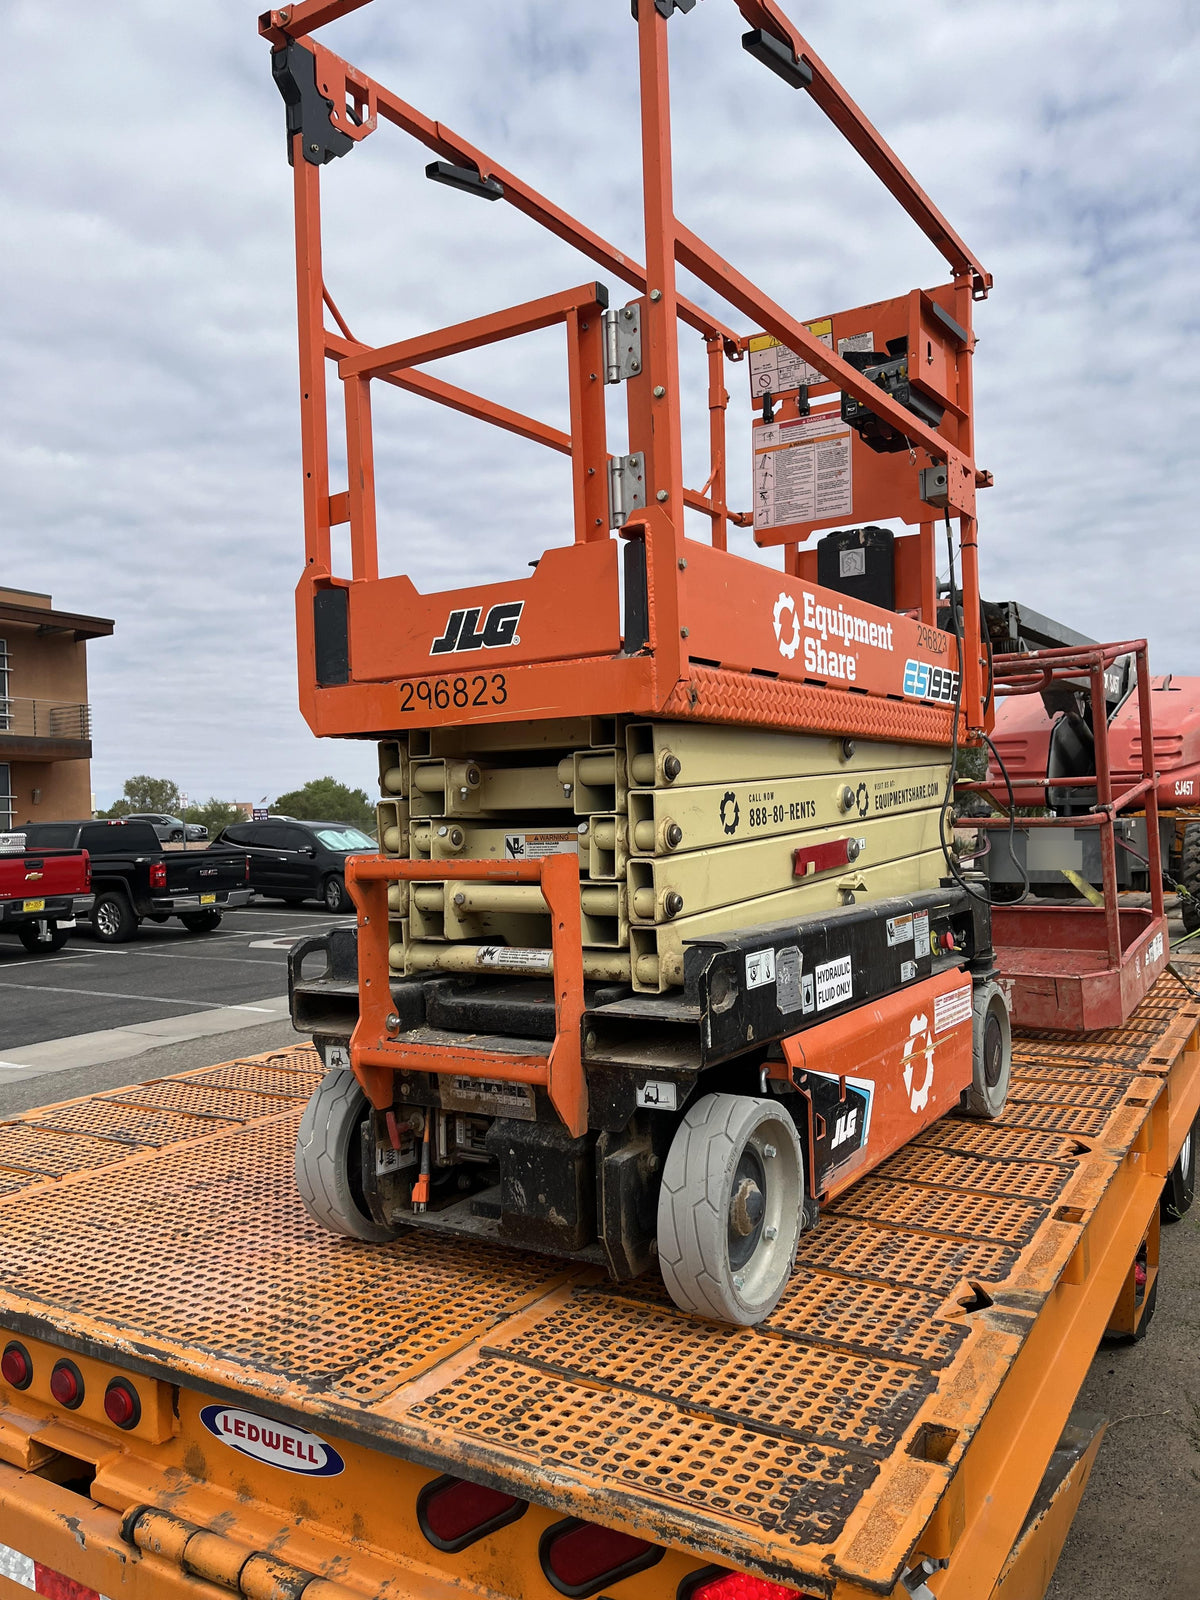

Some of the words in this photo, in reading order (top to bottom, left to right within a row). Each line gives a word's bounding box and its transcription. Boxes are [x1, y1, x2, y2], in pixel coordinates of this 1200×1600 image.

[429, 600, 525, 656] JLG
[802, 591, 894, 651] Equipment
[917, 625, 947, 652] 296823
[804, 637, 857, 681] Share
[399, 674, 508, 712] 296823
[748, 793, 762, 803] CALL
[763, 791, 775, 801] NOW
[874, 782, 939, 810] EQUIPMENTSHARE.COM
[1174, 781, 1194, 796] SJ45T
[749, 800, 816, 828] 888-80-RENTS
[816, 961, 851, 985] HYDRAULIC
[817, 986, 835, 1005] FLUID
[836, 980, 851, 997] ONLY
[830, 1108, 858, 1150] JLG
[222, 1415, 319, 1465] LEDWELL
